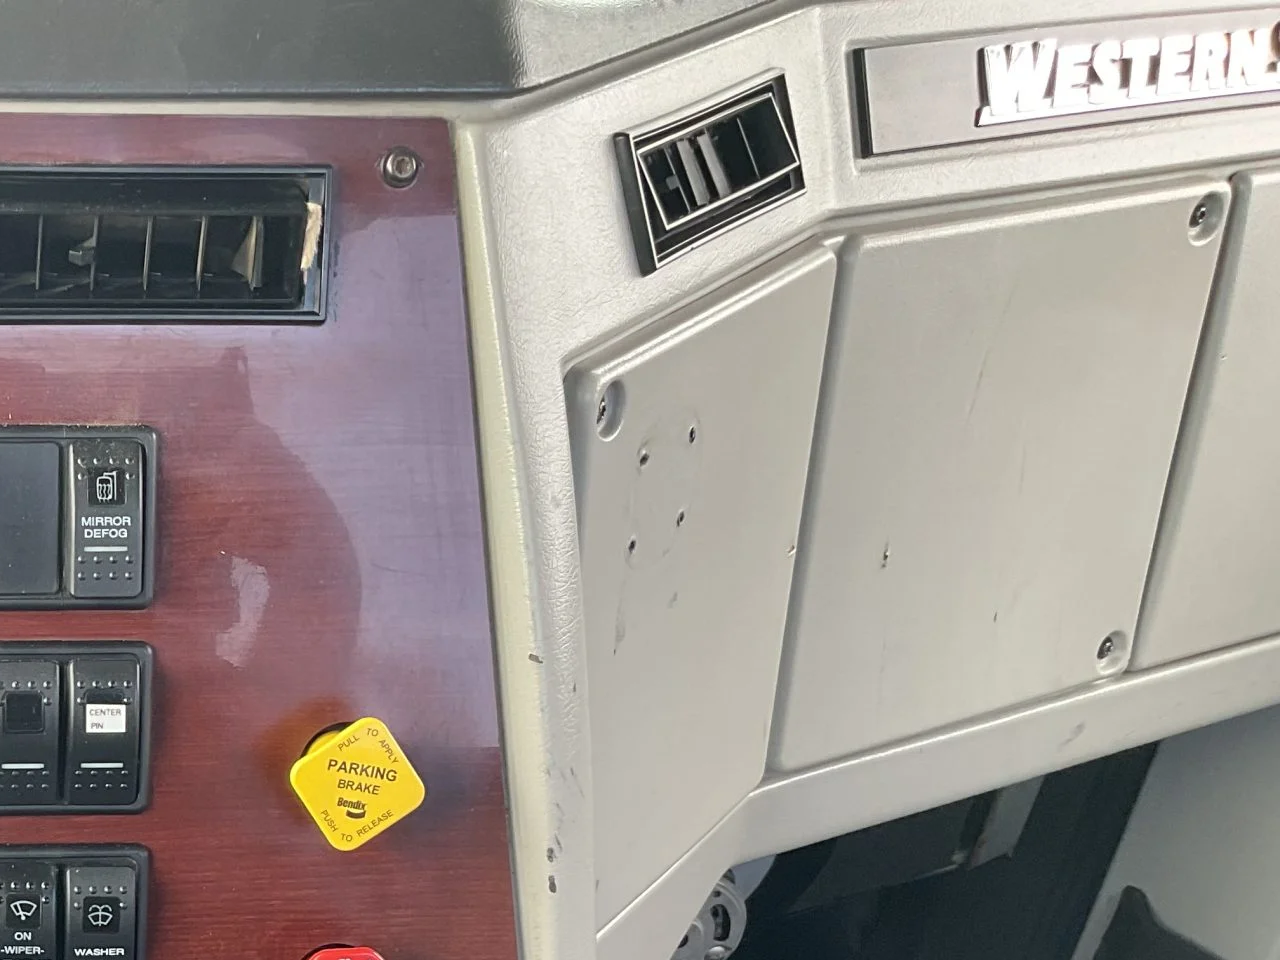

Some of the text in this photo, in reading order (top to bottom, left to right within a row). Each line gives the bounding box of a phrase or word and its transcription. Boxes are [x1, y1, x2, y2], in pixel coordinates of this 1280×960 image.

[982, 28, 1270, 117] WESTERN
[81, 515, 132, 527] MIRROR
[83, 528, 128, 539] DEFOG
[89, 709, 122, 717] CENTER
[90, 722, 104, 730] PIN
[337, 727, 400, 765] PULL TO APPLY
[327, 758, 398, 782] PARKING
[337, 779, 381, 796] BRAKE
[336, 797, 368, 811] Bendix
[320, 809, 395, 842] PUSH TO RELEASE
[14, 931, 32, 941] ON
[73, 947, 125, 956] WASHER
